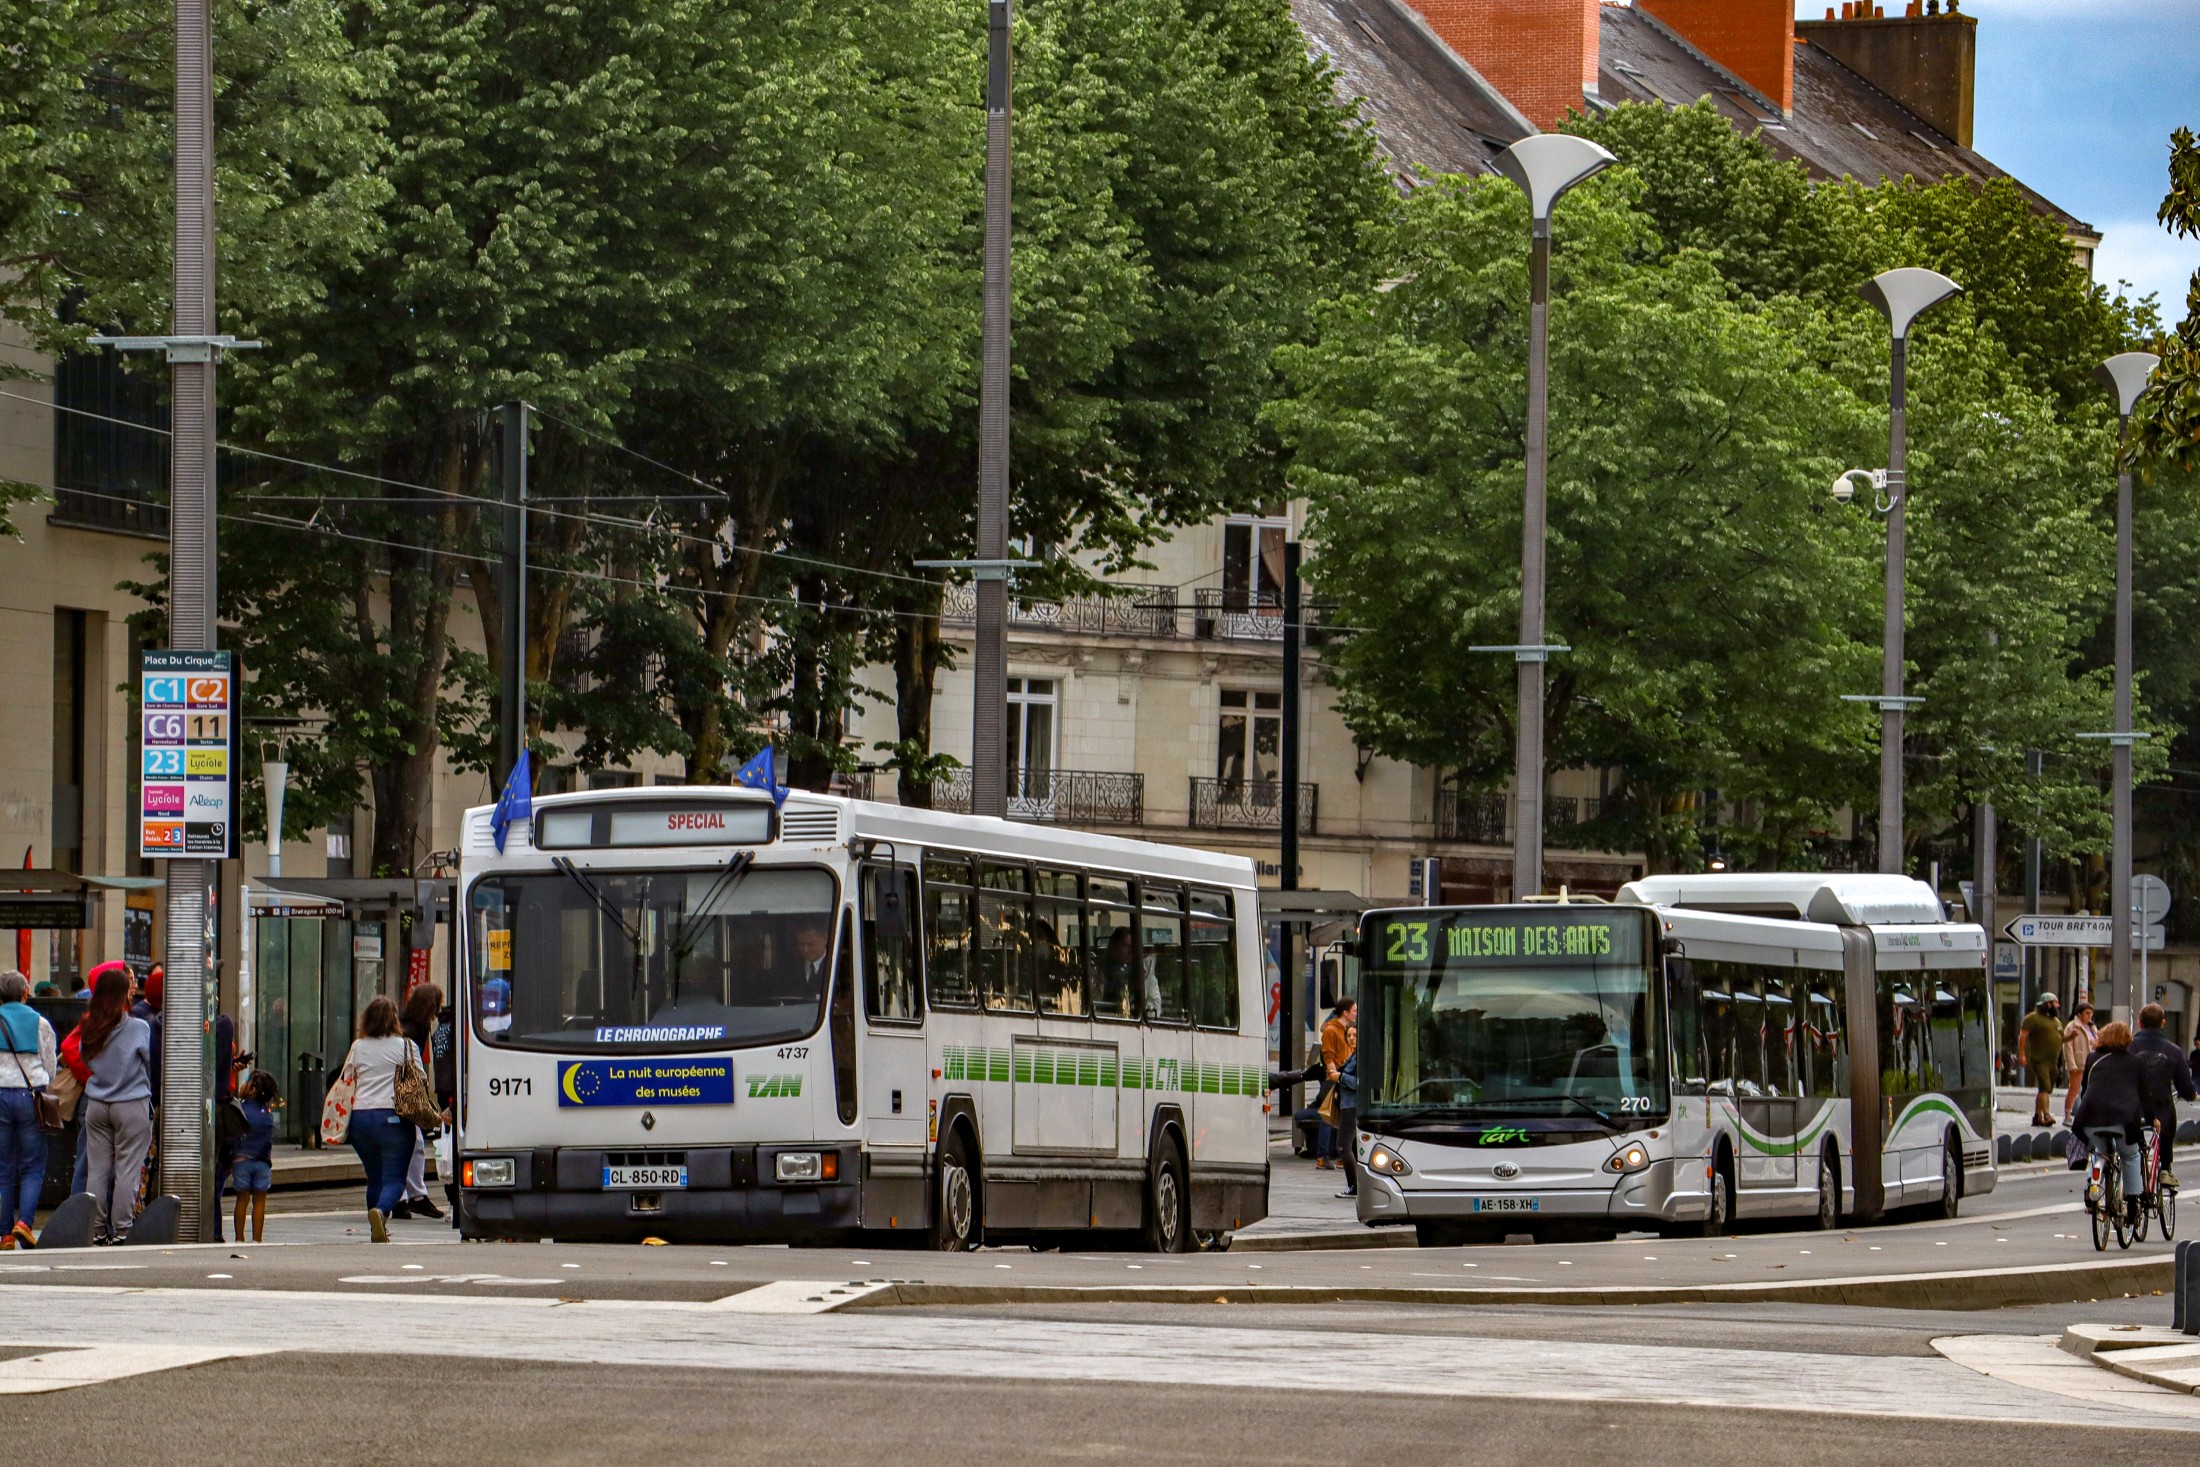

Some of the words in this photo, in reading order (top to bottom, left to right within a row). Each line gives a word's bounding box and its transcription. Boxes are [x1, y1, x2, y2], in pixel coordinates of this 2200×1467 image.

[144, 655, 167, 665] Place
[169, 655, 182, 665] Du
[184, 655, 213, 667] Cirque
[148, 679, 178, 702] C1
[190, 679, 223, 702] C2
[148, 715, 181, 738] C6
[193, 716, 219, 737] 11
[148, 751, 179, 773] 23
[667, 813, 726, 830] SPECIAL
[163, 830, 171, 841] 2
[174, 830, 181, 841] 3
[291, 908, 318, 916] Bretagne
[2039, 921, 2064, 931] TOUR
[1386, 922, 1429, 961] 23
[1448, 926, 1516, 956] MAISON
[1523, 926, 1558, 955] DES
[1566, 925, 1611, 955] ARTS
[596, 1028, 612, 1042] LE
[614, 1027, 723, 1042] CHRONOGRAPHE
[777, 1048, 809, 1059] 4737
[609, 1066, 625, 1079] La
[627, 1066, 652, 1078] nuit
[655, 1065, 726, 1081] européenne
[489, 1077, 532, 1096] 9171
[635, 1084, 655, 1098] des
[657, 1084, 701, 1098] musées
[745, 1073, 804, 1098] TAN
[1620, 1097, 1650, 1111] 270
[1479, 1126, 1530, 1146] tan
